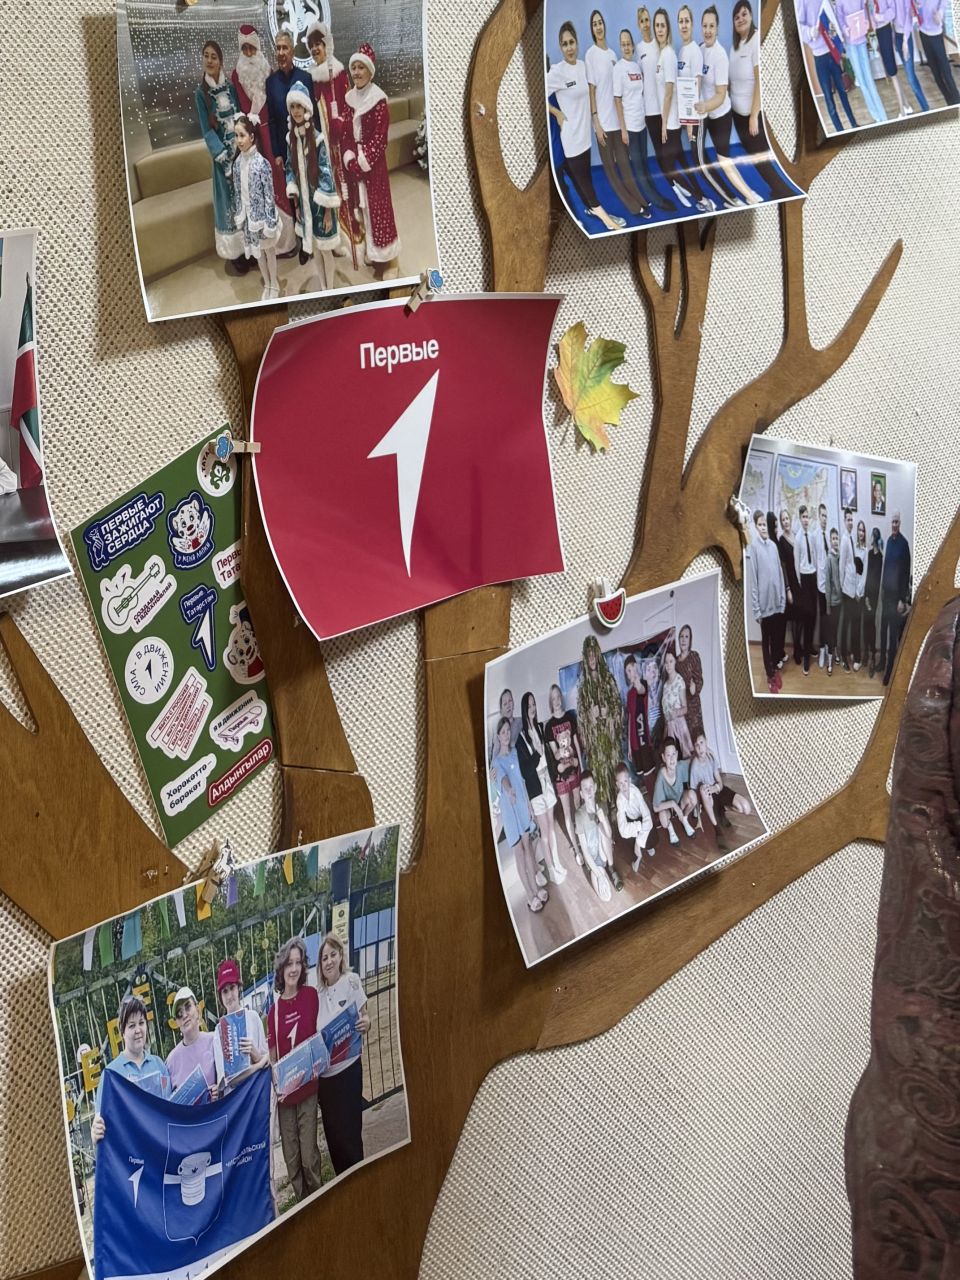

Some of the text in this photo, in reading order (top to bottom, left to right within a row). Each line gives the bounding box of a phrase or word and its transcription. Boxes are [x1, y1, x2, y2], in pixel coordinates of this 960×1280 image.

[360, 338, 440, 374] Первые
[101, 499, 145, 534] ПЕРВЫЕ
[104, 499, 161, 544] ЗАЖИГАЮТ
[107, 521, 150, 553] СЕРДЦА
[211, 745, 270, 800] Алдынгылар
